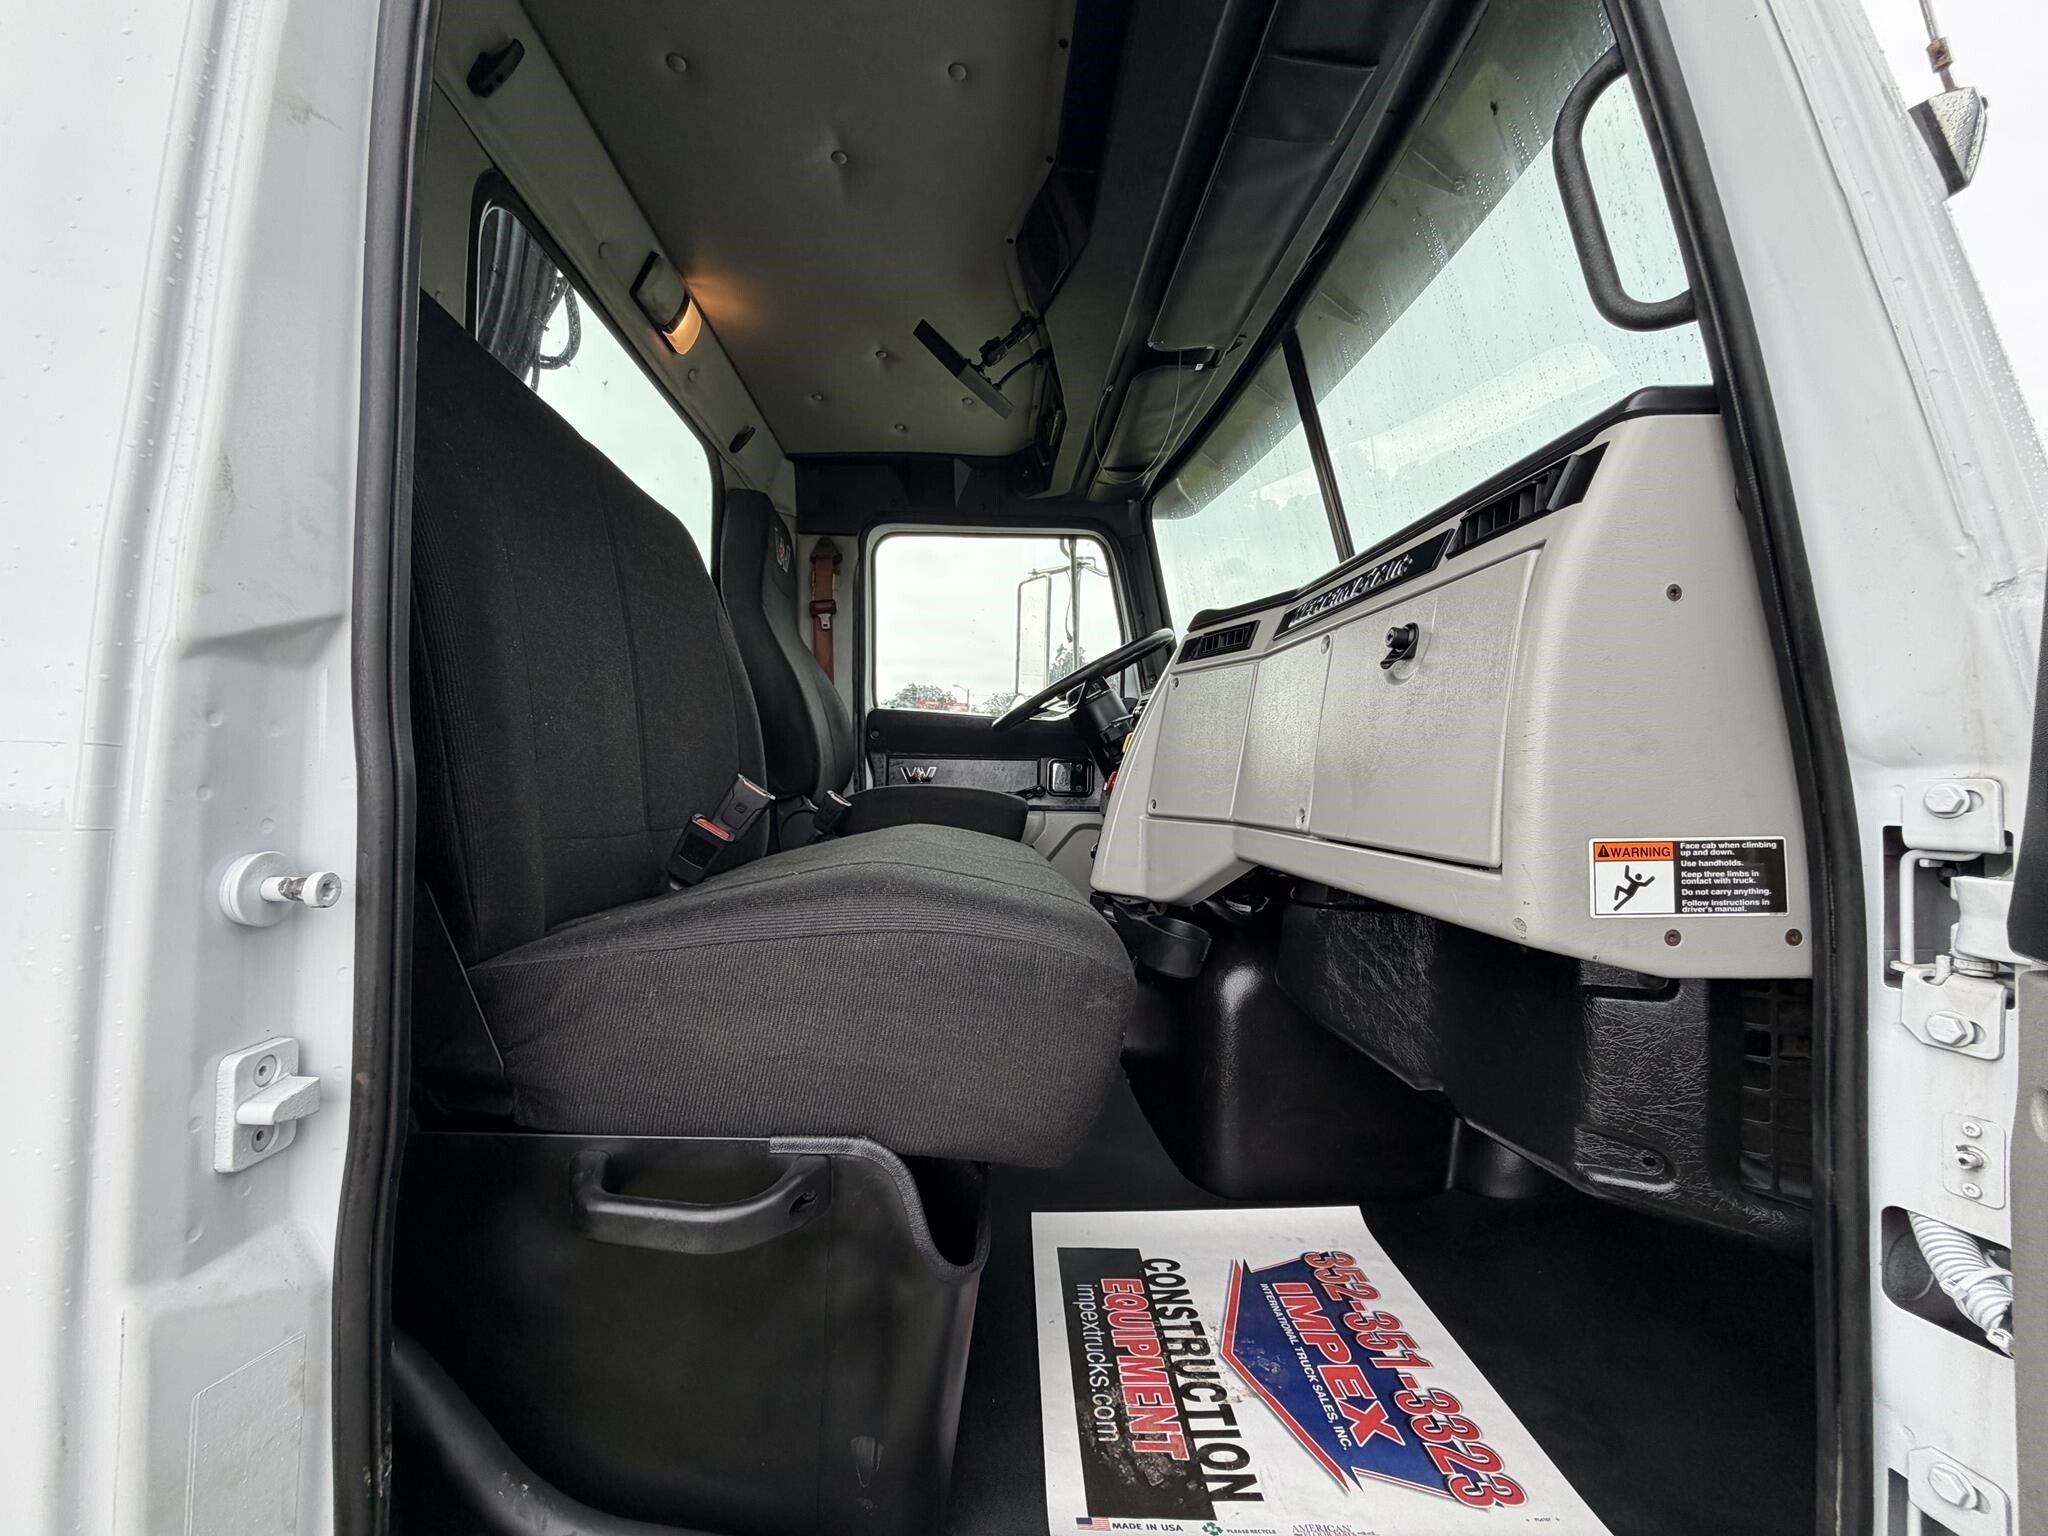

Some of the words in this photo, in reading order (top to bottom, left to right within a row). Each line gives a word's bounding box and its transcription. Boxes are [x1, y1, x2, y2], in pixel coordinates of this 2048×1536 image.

[1610, 846, 1671, 858] WARNING
[1681, 871, 1702, 879] Keep
[1734, 888, 1772, 896] anything.
[1742, 841, 1777, 850] climbing
[1073, 1284, 1121, 1442] impextrucks.com
[1100, 1278, 1190, 1461] EQUIPMENT
[1141, 1258, 1265, 1502] CONSTRUCTION
[1260, 1283, 1300, 1345] INTERNATIONAL
[1294, 1348, 1319, 1382] TRUCK
[1312, 1384, 1338, 1423] SALES,
[1334, 1426, 1352, 1450] INC.
[1272, 1283, 1406, 1447] IMPEX
[1301, 1251, 1527, 1508] 352-351-3323
[1112, 1522, 1143, 1530] MADE
[1161, 1524, 1183, 1532] USA
